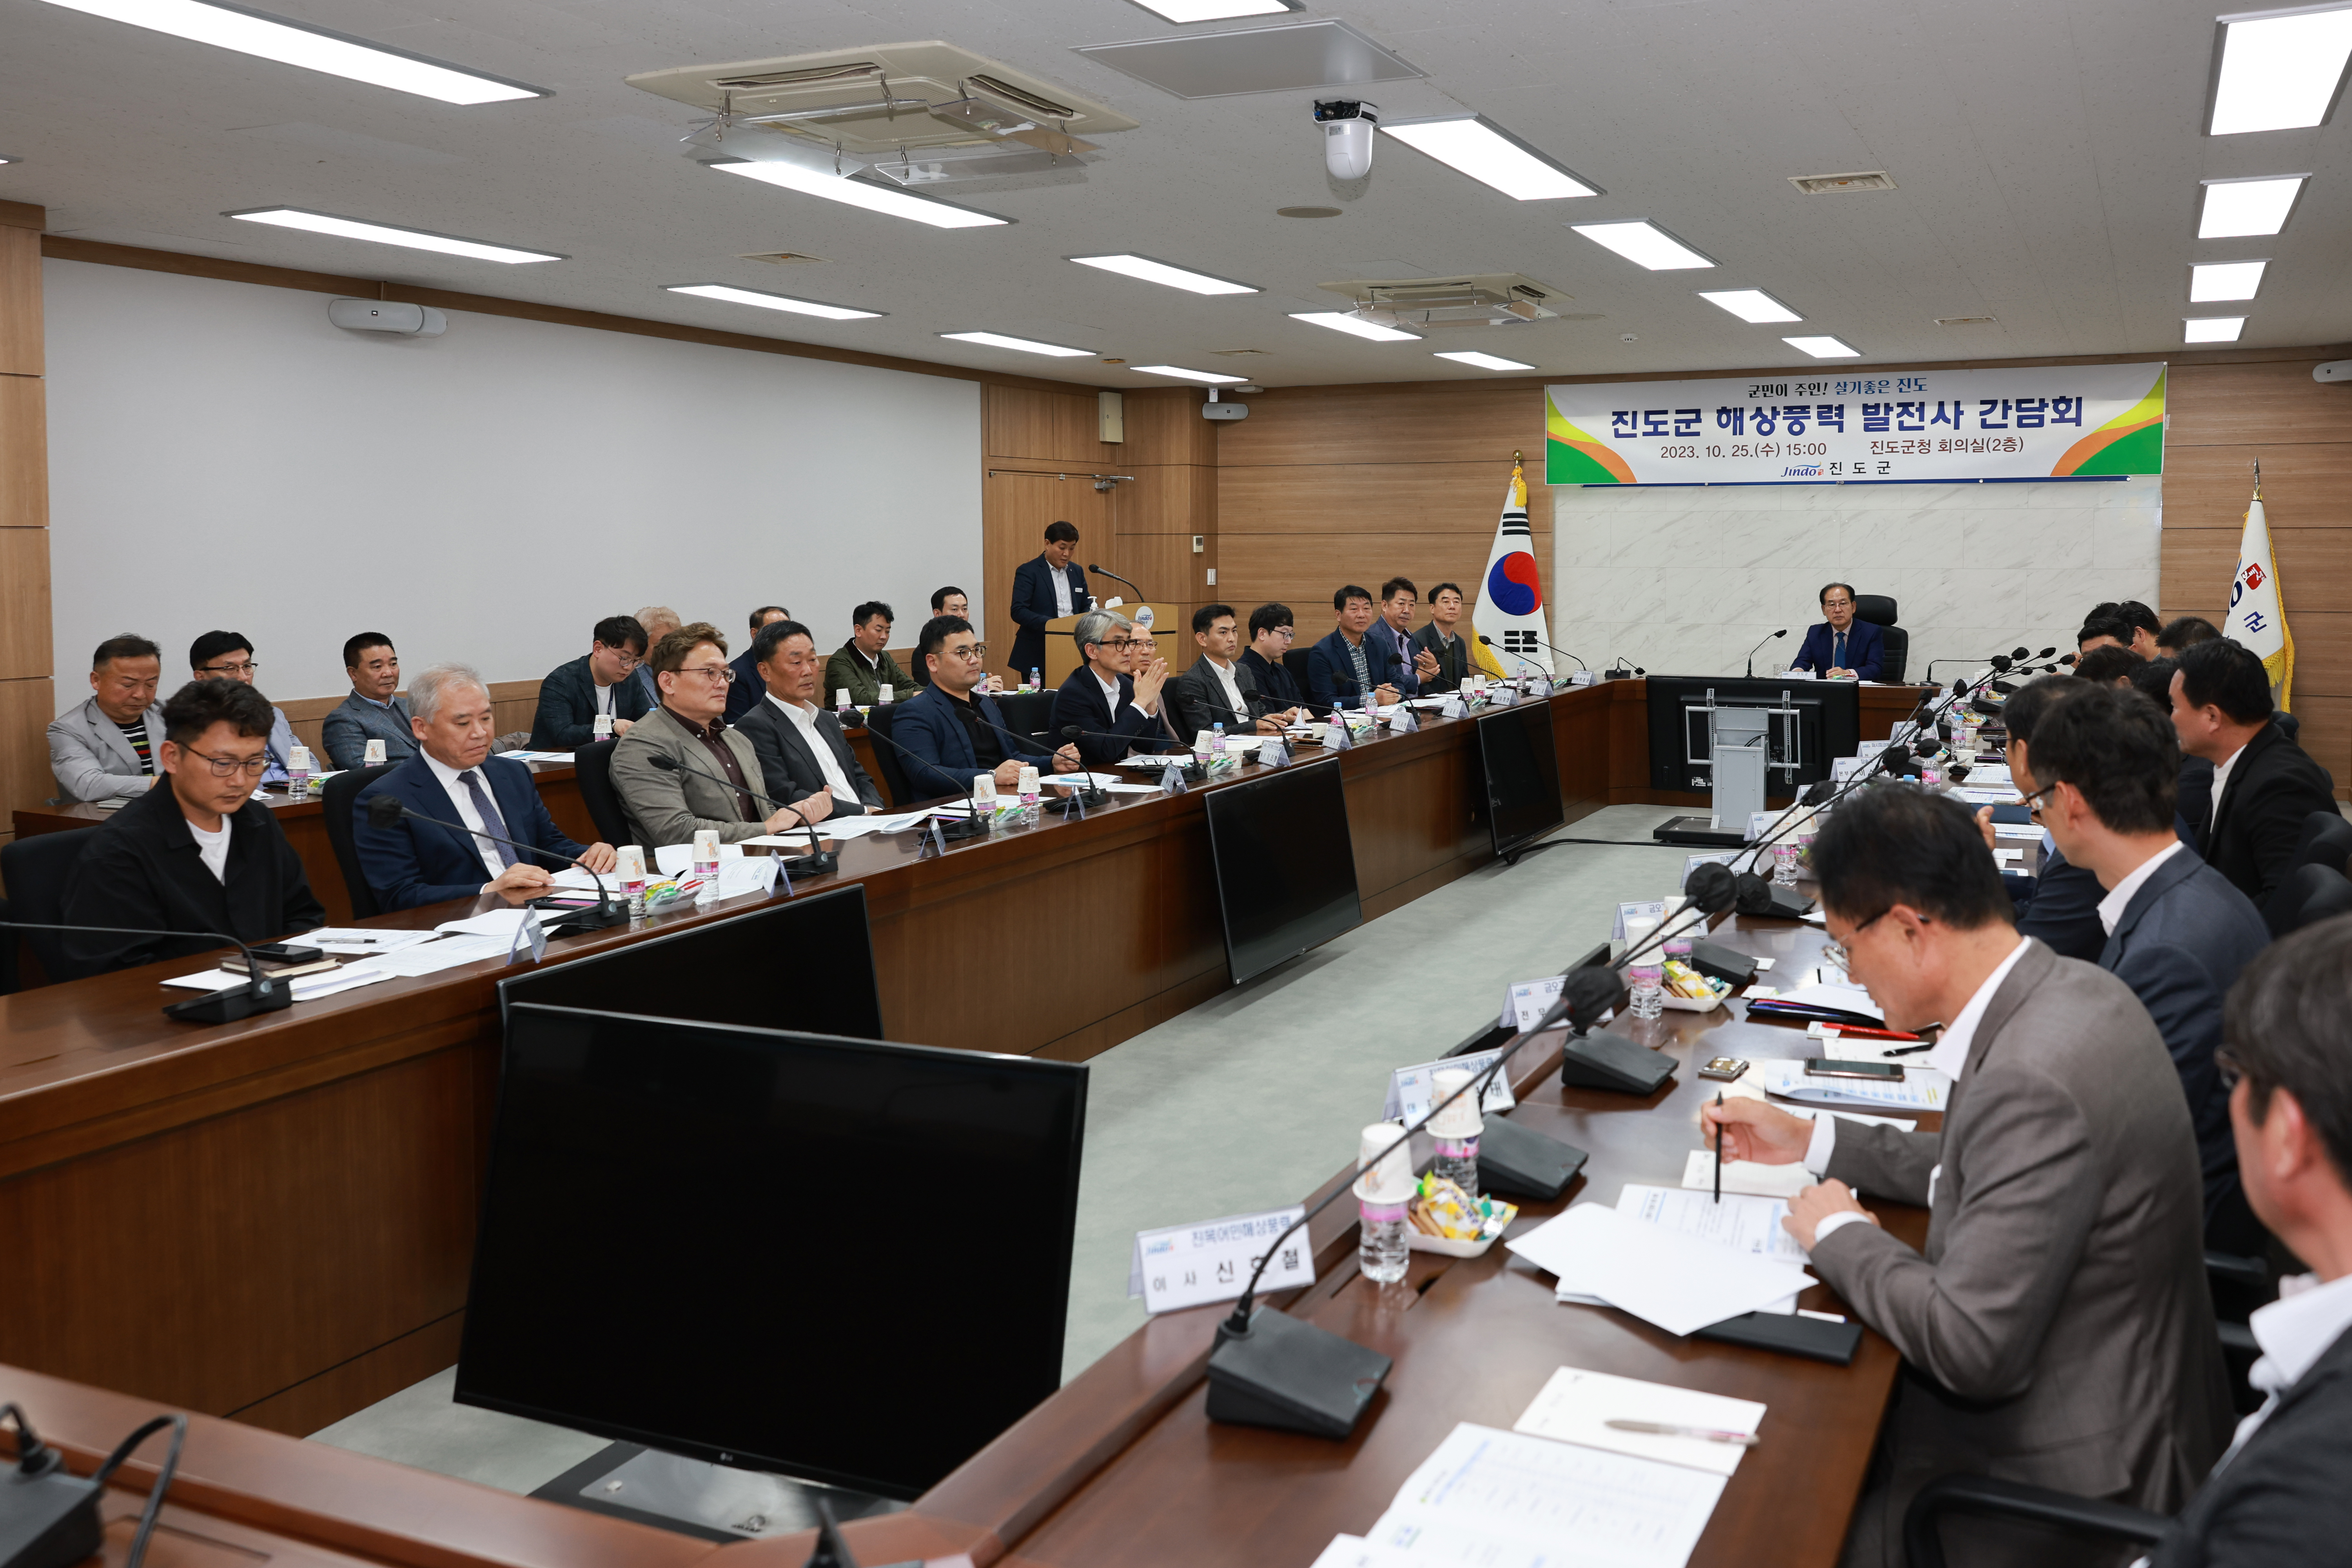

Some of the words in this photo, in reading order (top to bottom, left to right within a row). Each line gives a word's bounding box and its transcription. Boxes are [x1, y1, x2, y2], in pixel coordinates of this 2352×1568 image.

[1748, 383, 1788, 398] 군민이
[1794, 382, 1828, 397] 주인!
[1834, 379, 1891, 395] 살기좋은
[1896, 377, 1928, 393] 진도
[1611, 408, 1702, 439] 진도군
[1716, 403, 1845, 436] 해상풍력
[1861, 400, 1964, 432] 발전사
[1978, 395, 2083, 429] 간담회
[1661, 446, 1700, 459] 2023.
[1706, 445, 1726, 458] 10.
[1786, 443, 1827, 456] 15:00
[1870, 439, 1931, 455] 진도군청
[1938, 436, 2024, 454] 회의실(2층)
[1781, 466, 1817, 477] Jindo
